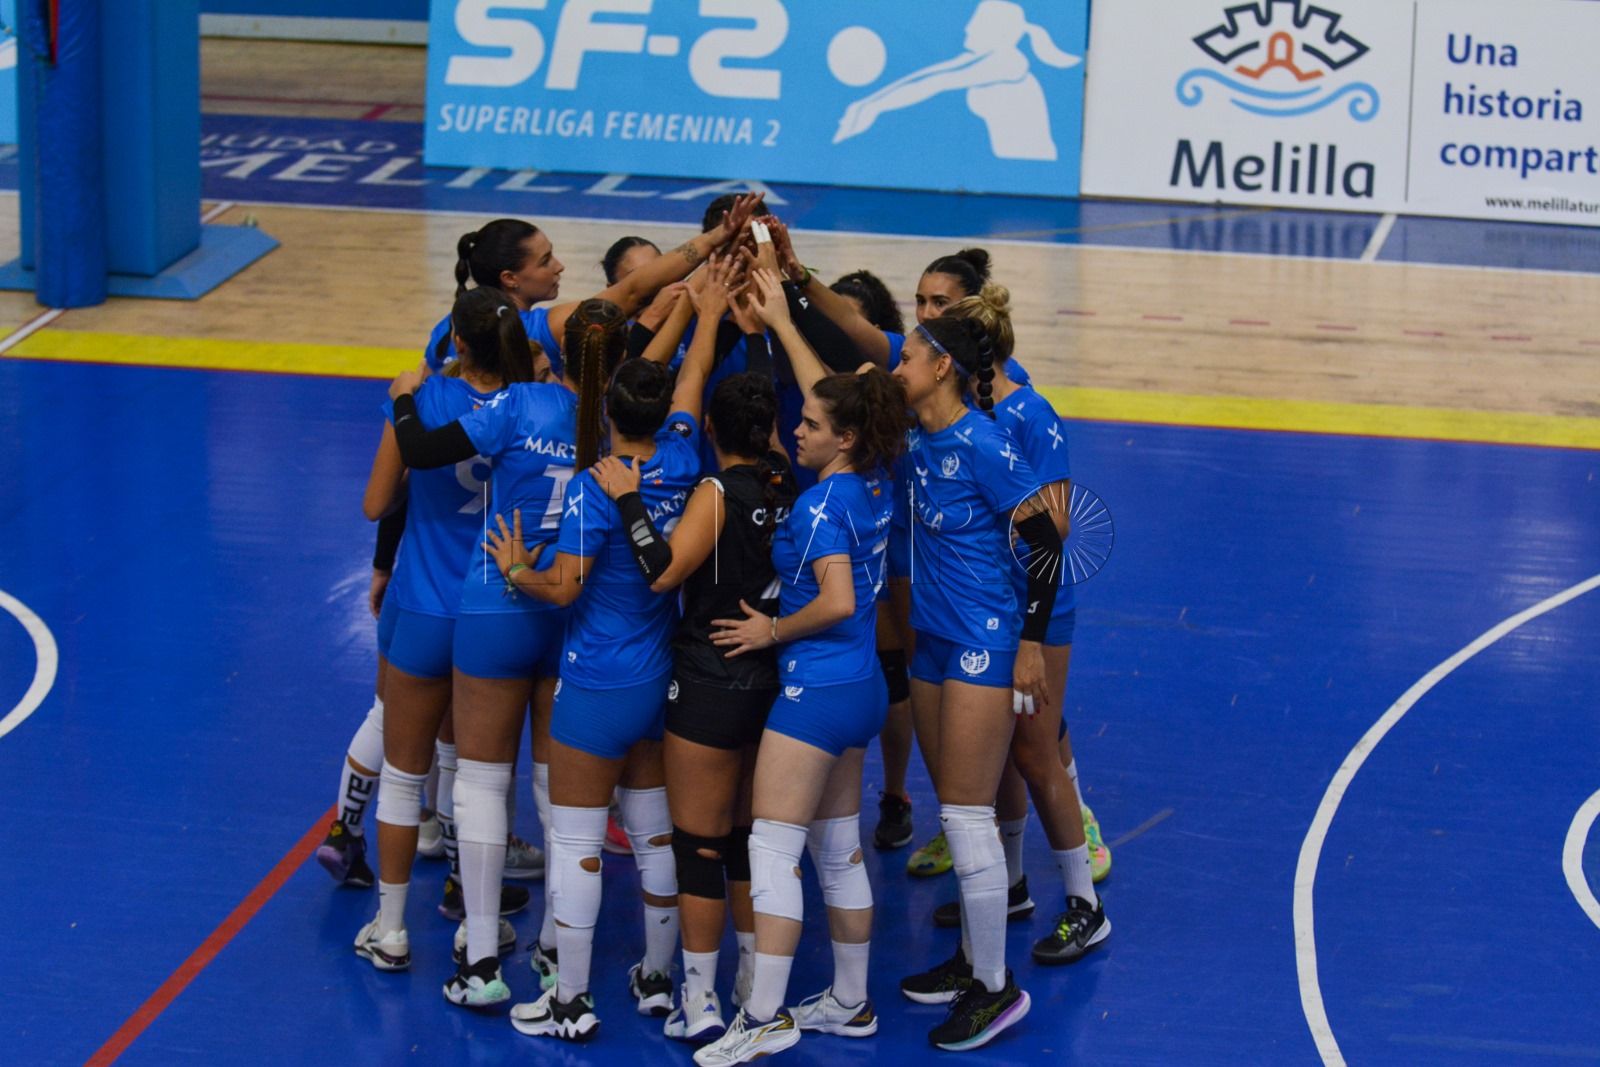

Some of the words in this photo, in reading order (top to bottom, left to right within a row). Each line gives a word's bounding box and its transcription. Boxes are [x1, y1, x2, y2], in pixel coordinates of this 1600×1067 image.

[445, 0, 789, 100] SF-2
[1447, 33, 1518, 67] Una
[1443, 83, 1583, 122] historia
[200, 134, 398, 153] IUDAD
[438, 103, 594, 137] SUPERLIGA
[604, 111, 752, 145] FEMENINA
[761, 119, 781, 147] 2
[1169, 138, 1376, 199] Melilla
[1440, 142, 1600, 180] compart
